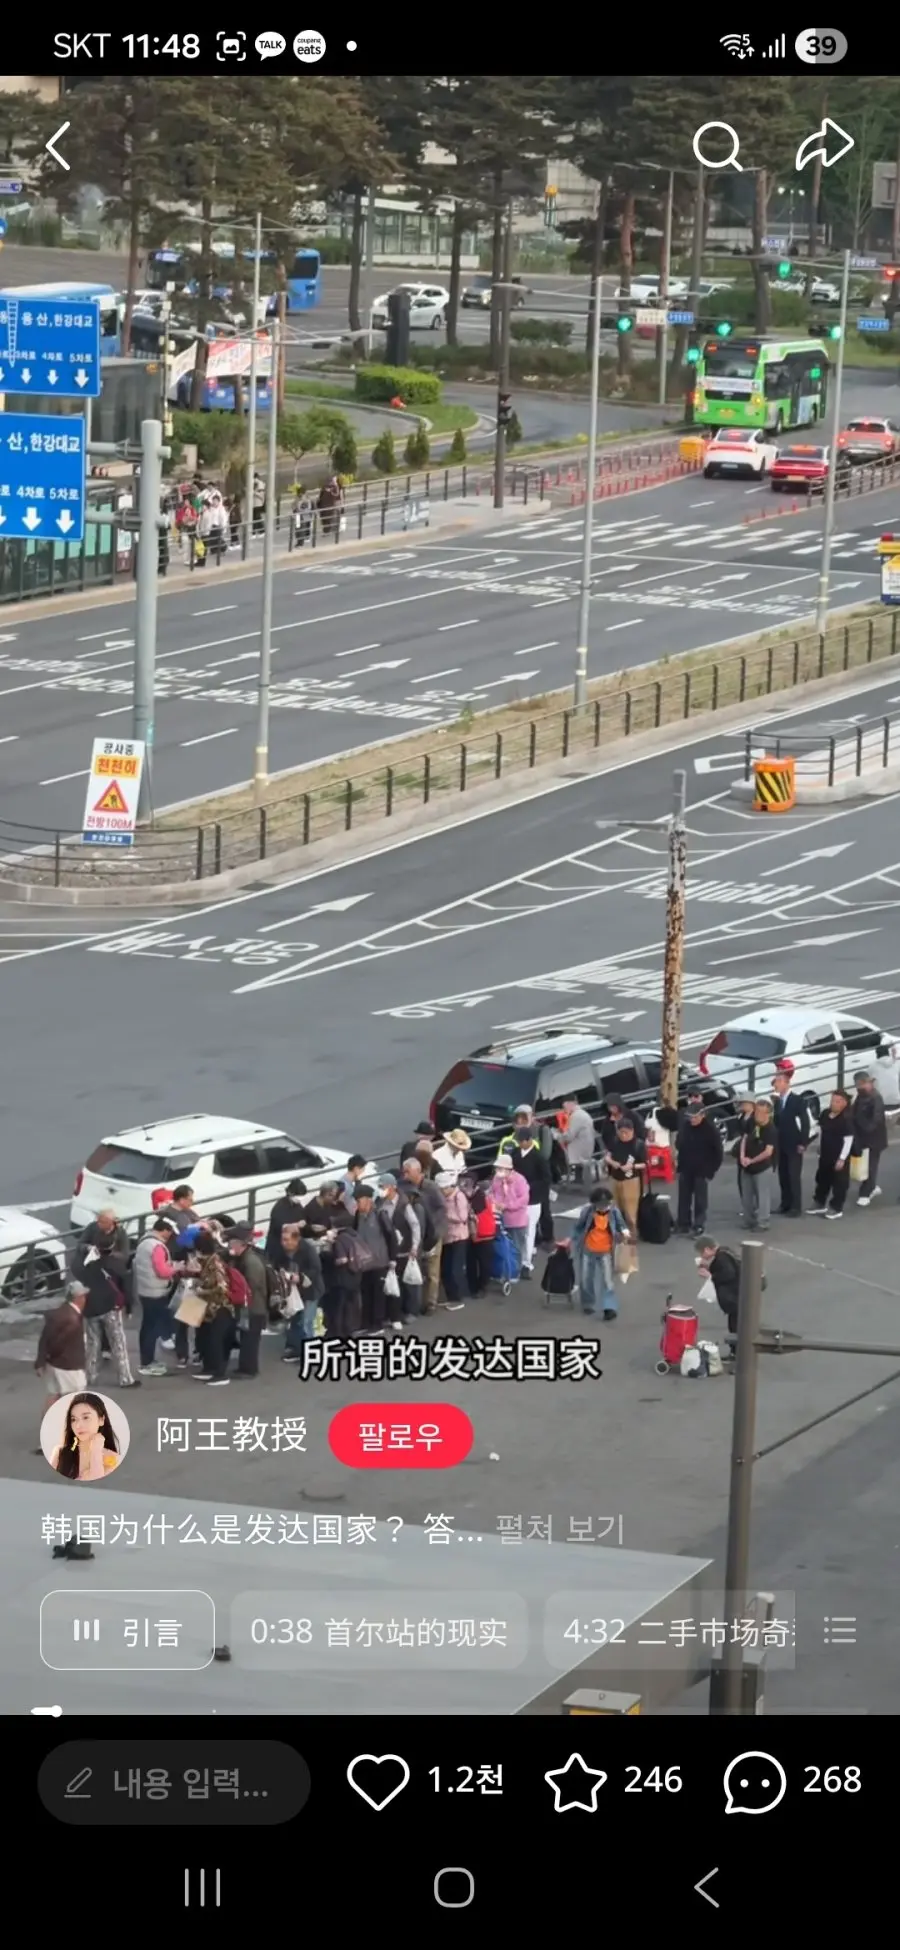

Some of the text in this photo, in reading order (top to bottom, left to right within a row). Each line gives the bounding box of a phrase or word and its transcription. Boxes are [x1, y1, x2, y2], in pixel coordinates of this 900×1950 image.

[41, 351, 64, 362] 4차로
[69, 353, 93, 364] 5차로
[16, 485, 45, 499] 4차로
[49, 487, 80, 501] 5차로
[104, 742, 135, 756] 공사중
[98, 758, 138, 775] 천천히
[88, 930, 320, 966] 버스전용
